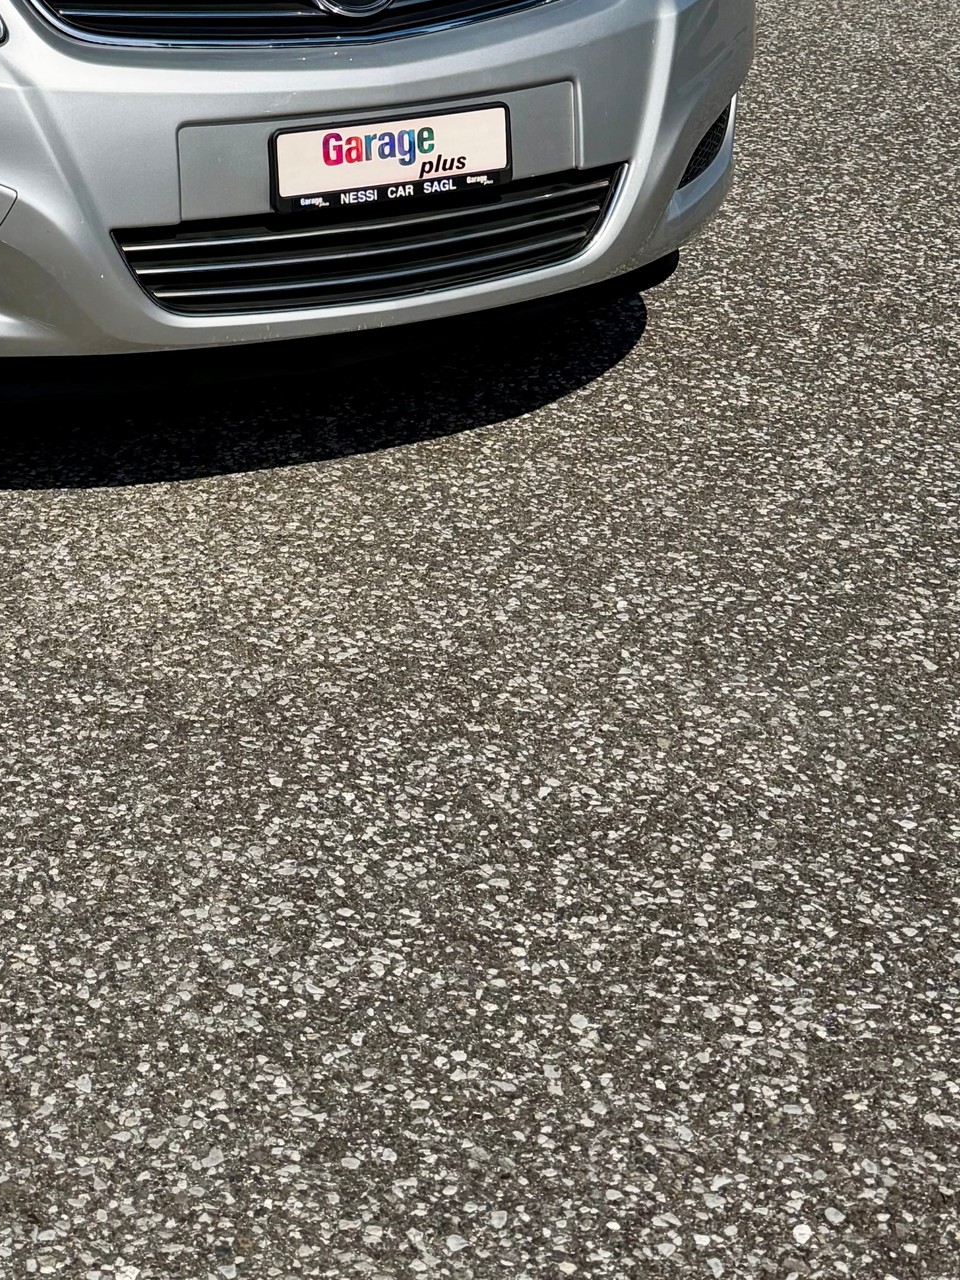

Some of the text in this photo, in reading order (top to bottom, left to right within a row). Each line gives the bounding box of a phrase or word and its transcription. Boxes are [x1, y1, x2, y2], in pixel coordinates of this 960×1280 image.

[322, 126, 435, 167] Garage
[418, 154, 467, 179] plus
[340, 179, 457, 205] NESSI CAR SAGL
[466, 175, 487, 184] Garage
[300, 197, 323, 206] Garage
